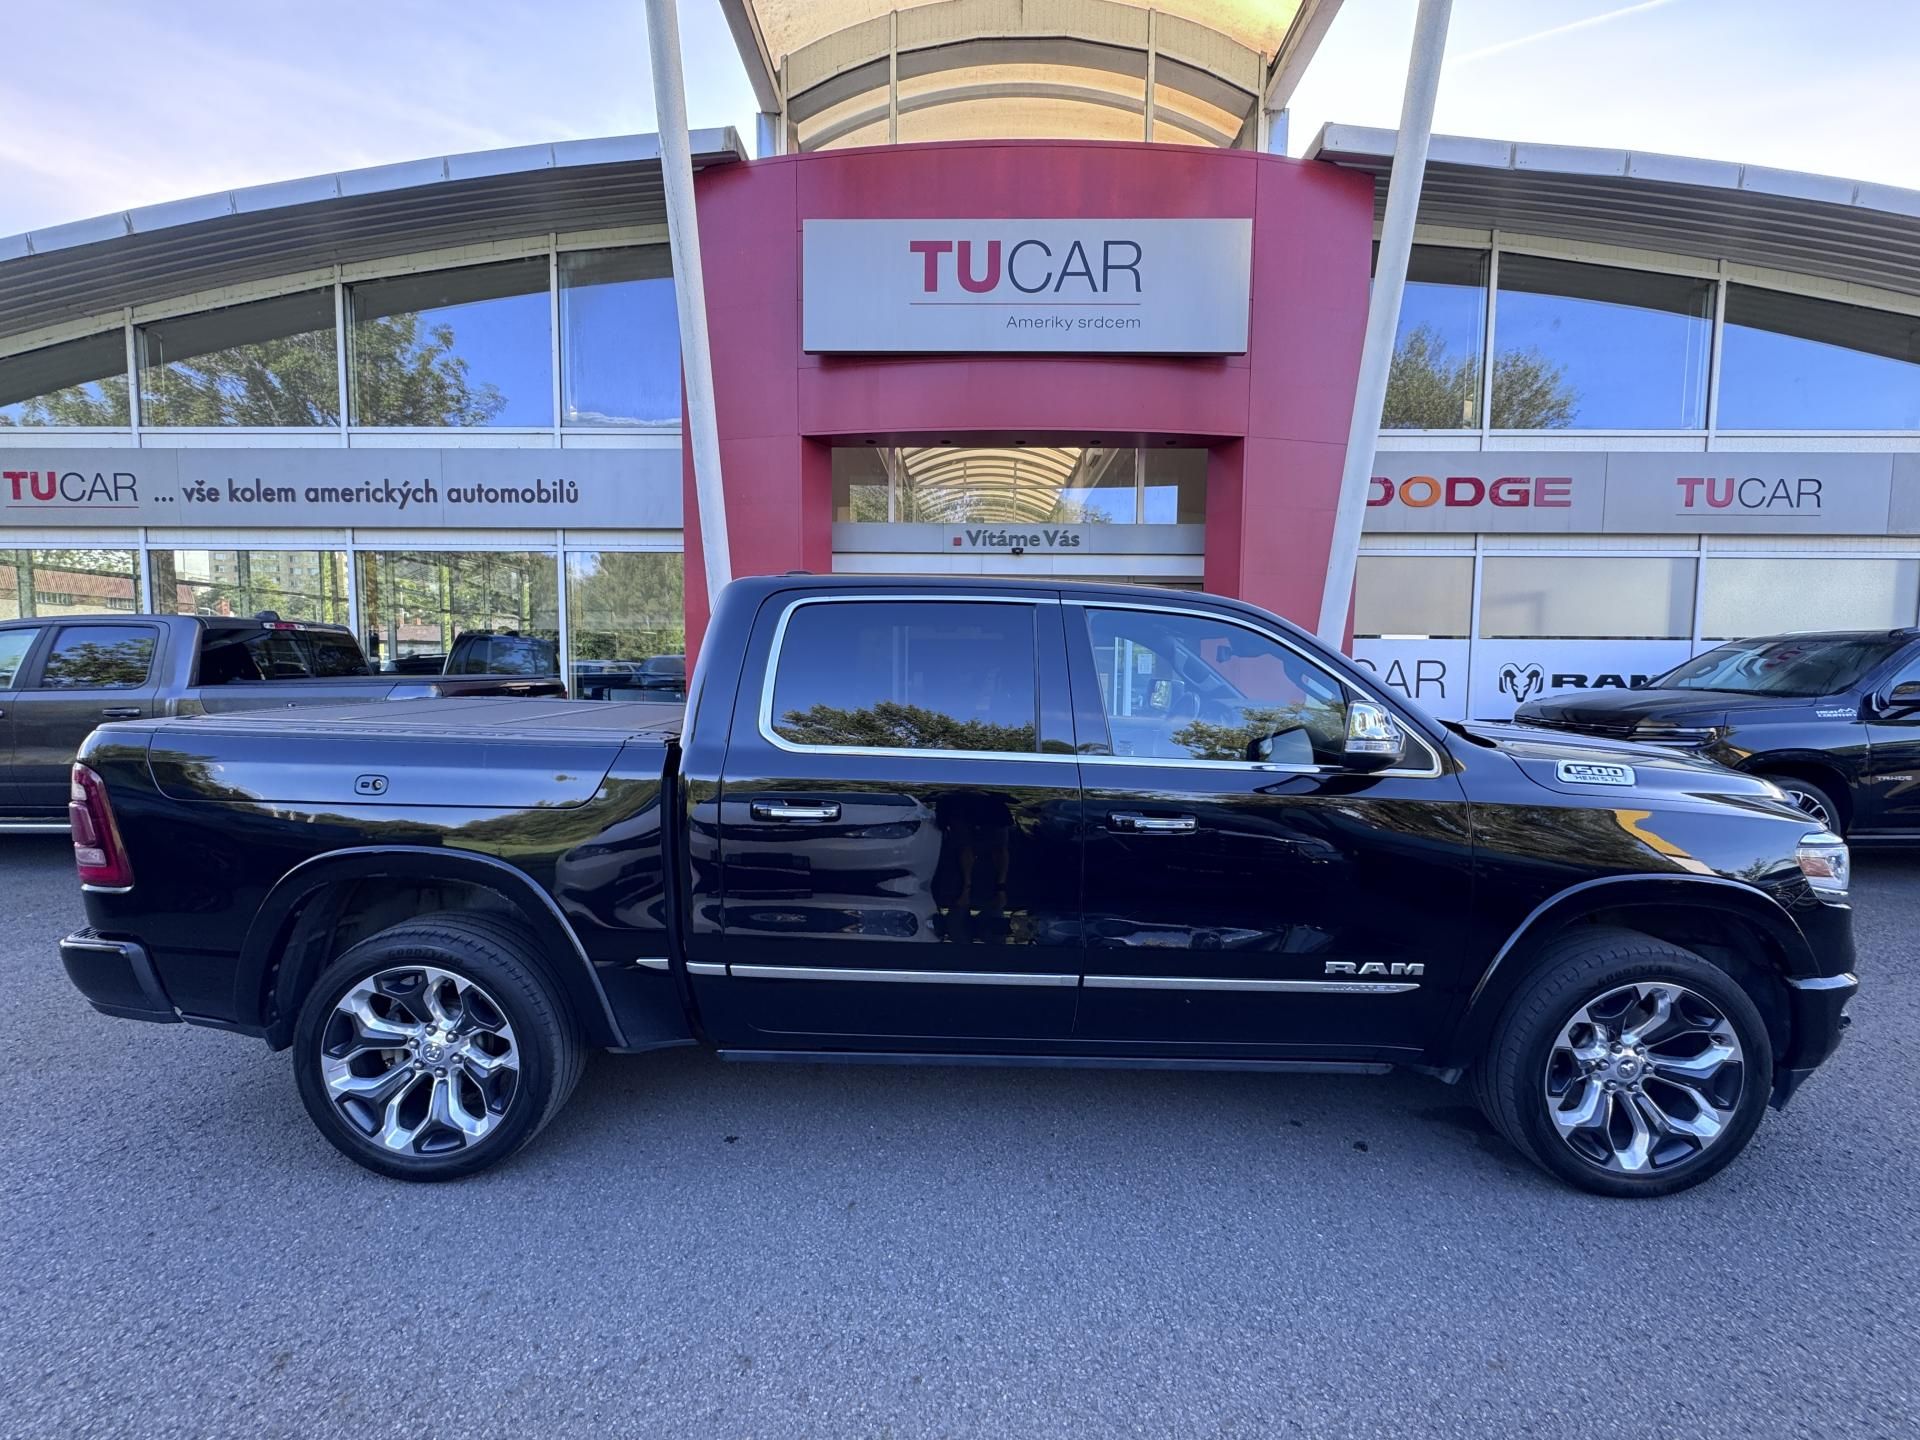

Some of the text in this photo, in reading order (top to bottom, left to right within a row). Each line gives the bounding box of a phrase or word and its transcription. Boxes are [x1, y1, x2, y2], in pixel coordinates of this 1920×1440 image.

[909, 239, 1143, 294] TUCAR
[1006, 315, 1141, 332] Ameriky srdcem
[3, 471, 138, 502] TUCAR
[182, 479, 220, 503] vše
[228, 478, 296, 503] kolem
[304, 478, 438, 510] amerických
[446, 478, 579, 504] automobilů
[1366, 476, 1573, 507] DODGE
[1676, 477, 1822, 509] TUCAR
[965, 529, 1080, 547] Vítáme Vás
[1567, 765, 1623, 777] 1500
[1324, 961, 1425, 976] RAM
